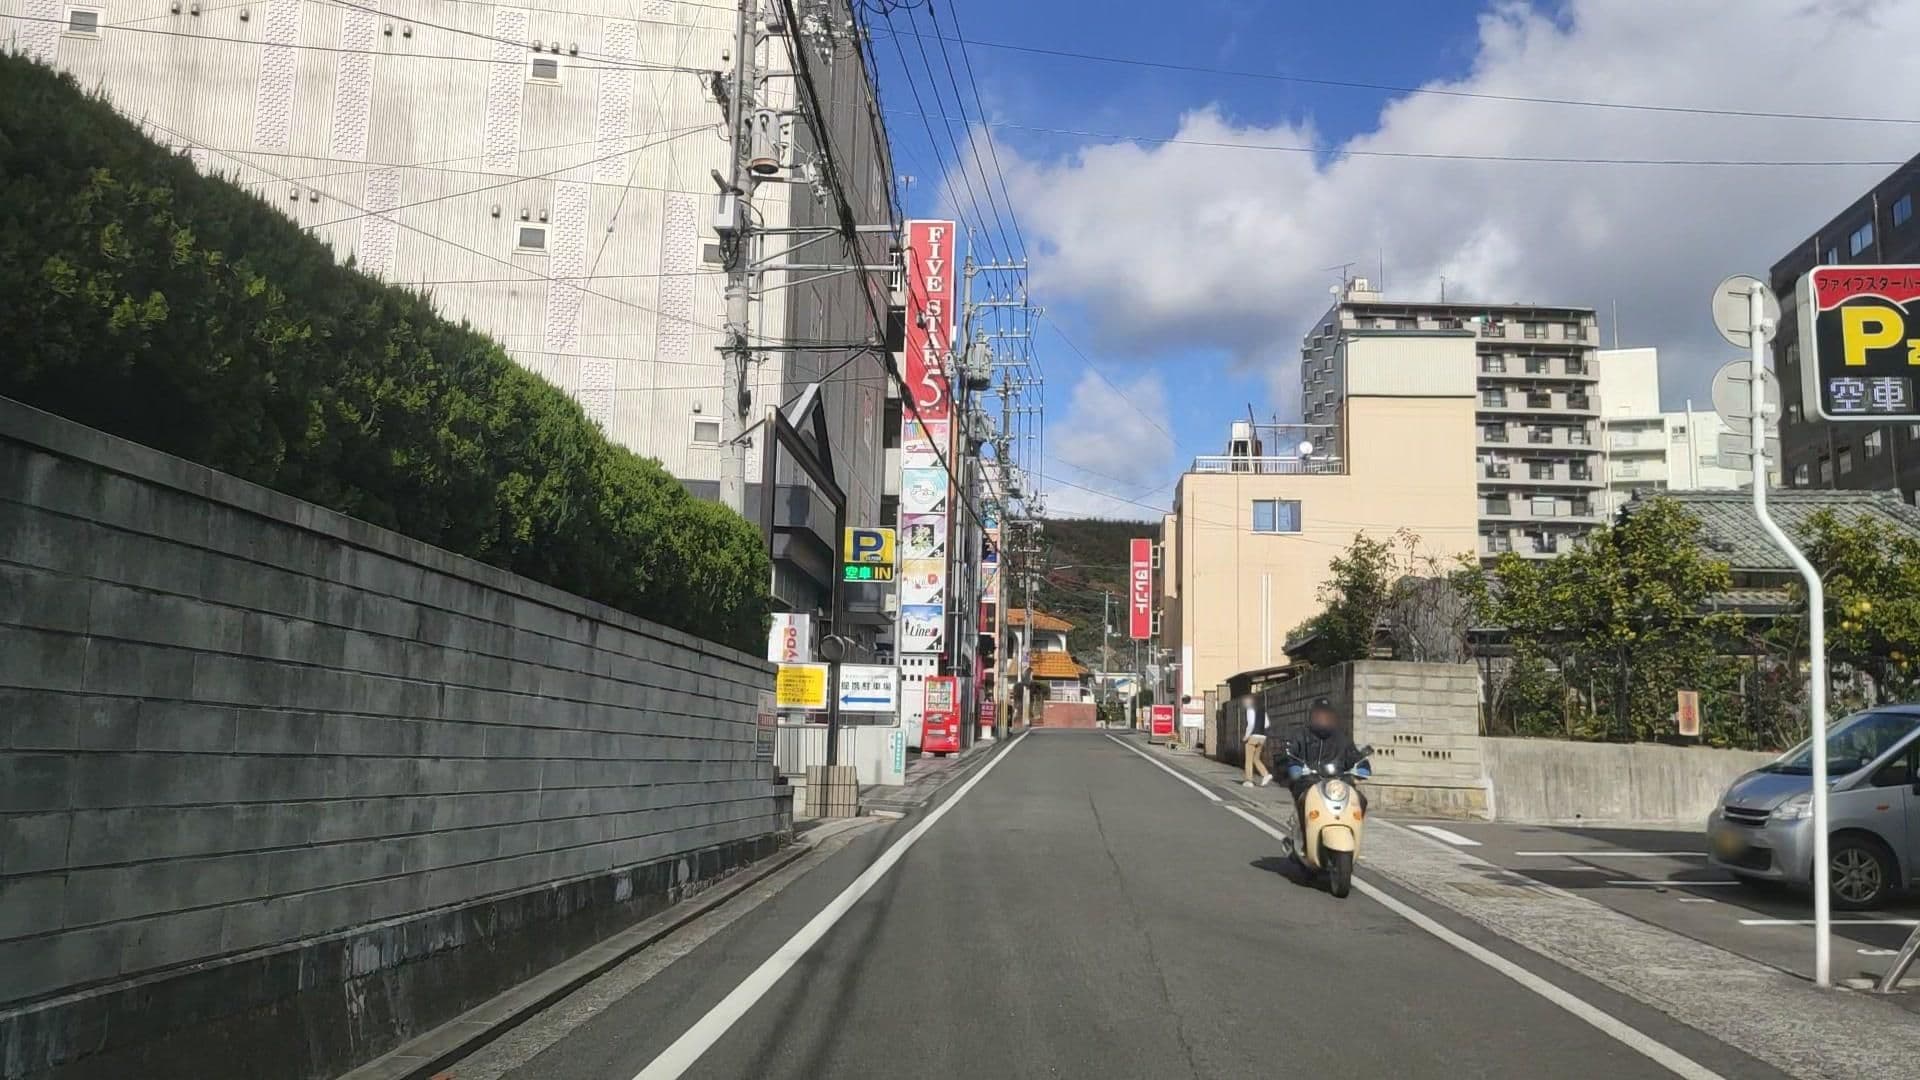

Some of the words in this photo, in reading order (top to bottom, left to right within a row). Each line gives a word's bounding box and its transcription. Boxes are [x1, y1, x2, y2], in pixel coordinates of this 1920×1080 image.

[925, 226, 945, 292] FIVE
[923, 299, 942, 366] STAR
[919, 368, 942, 407] 5
[1830, 377, 1906, 412] 空車
[852, 530, 883, 561] P
[845, 566, 871, 580] 空車
[874, 566, 891, 580] IN
